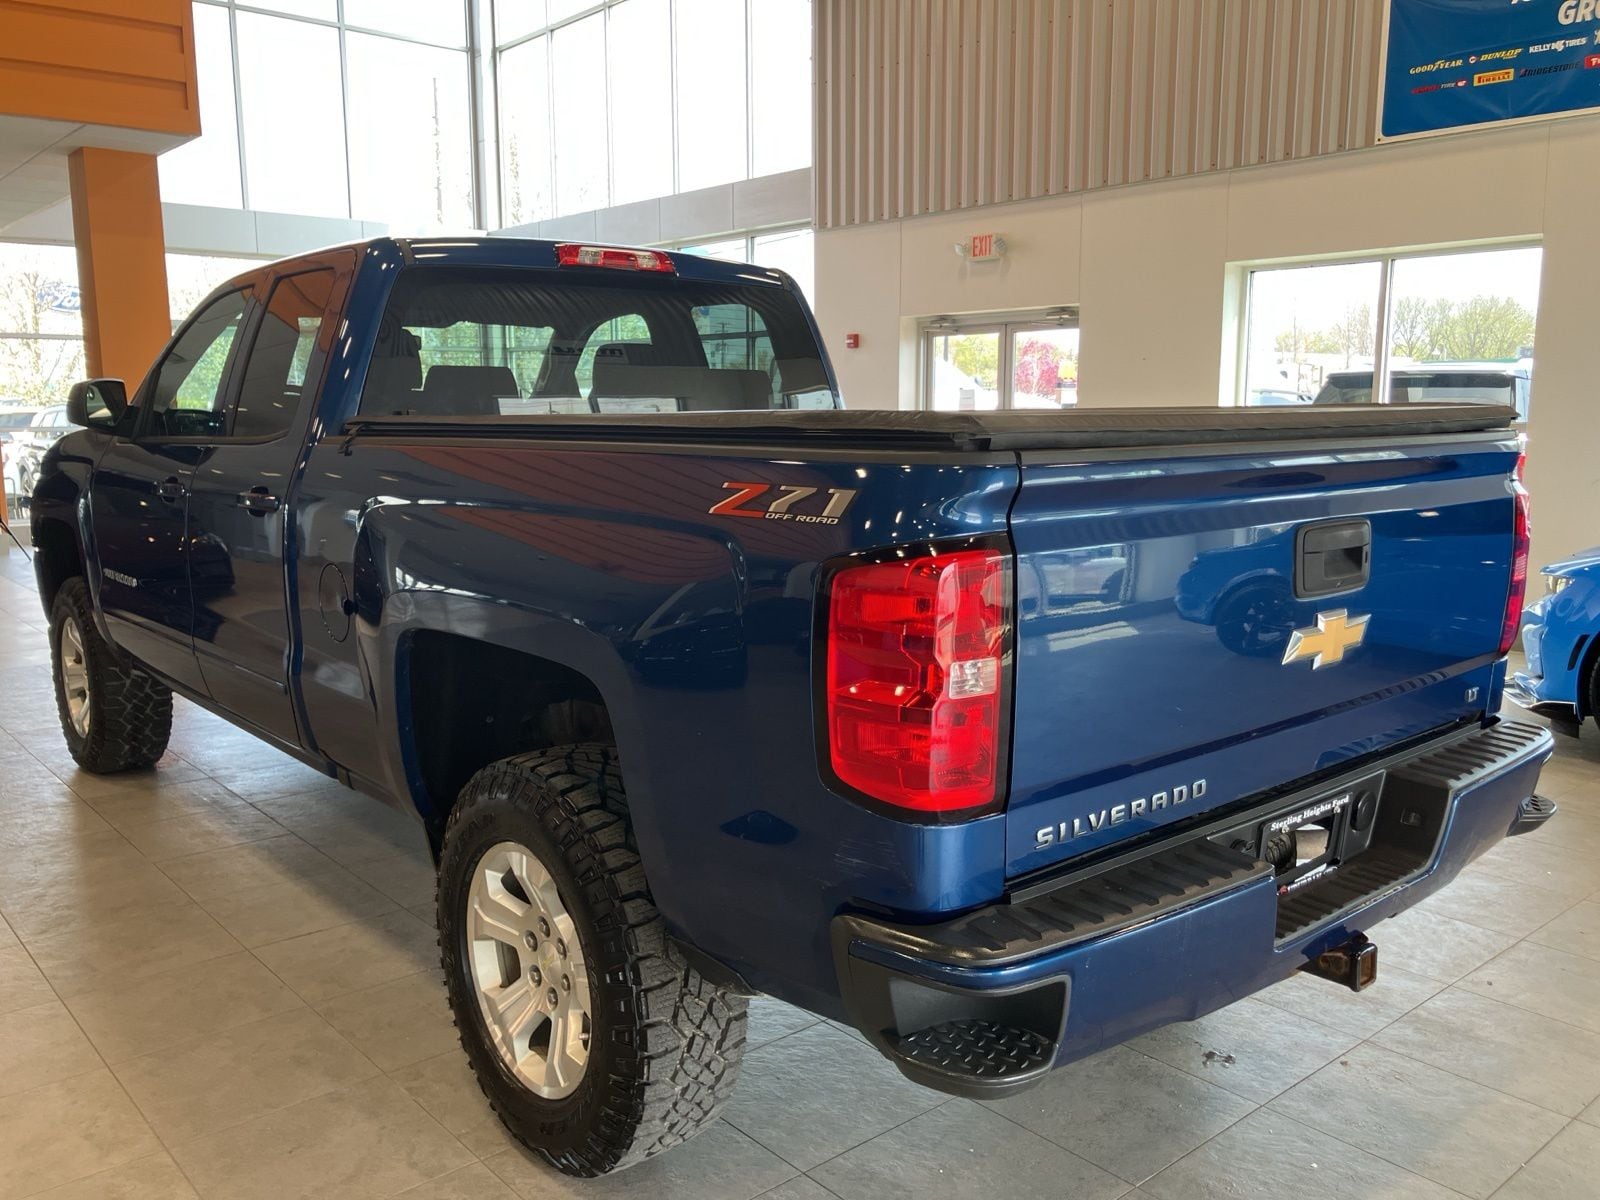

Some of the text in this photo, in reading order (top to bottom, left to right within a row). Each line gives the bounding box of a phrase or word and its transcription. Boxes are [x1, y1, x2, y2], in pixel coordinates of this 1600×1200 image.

[1558, 0, 1600, 25] GR
[1480, 48, 1522, 61] DUNLOP
[1529, 44, 1553, 53] KELLY
[1565, 37, 1587, 47] TIRES
[1409, 60, 1463, 75] GOODYEAR
[972, 235, 992, 257] EXIT
[708, 482, 856, 518] Z71
[765, 512, 839, 525] OFF ROAD
[1035, 779, 1207, 849] SILVERADO
[1270, 794, 1350, 831] Sterling Heights Ford
